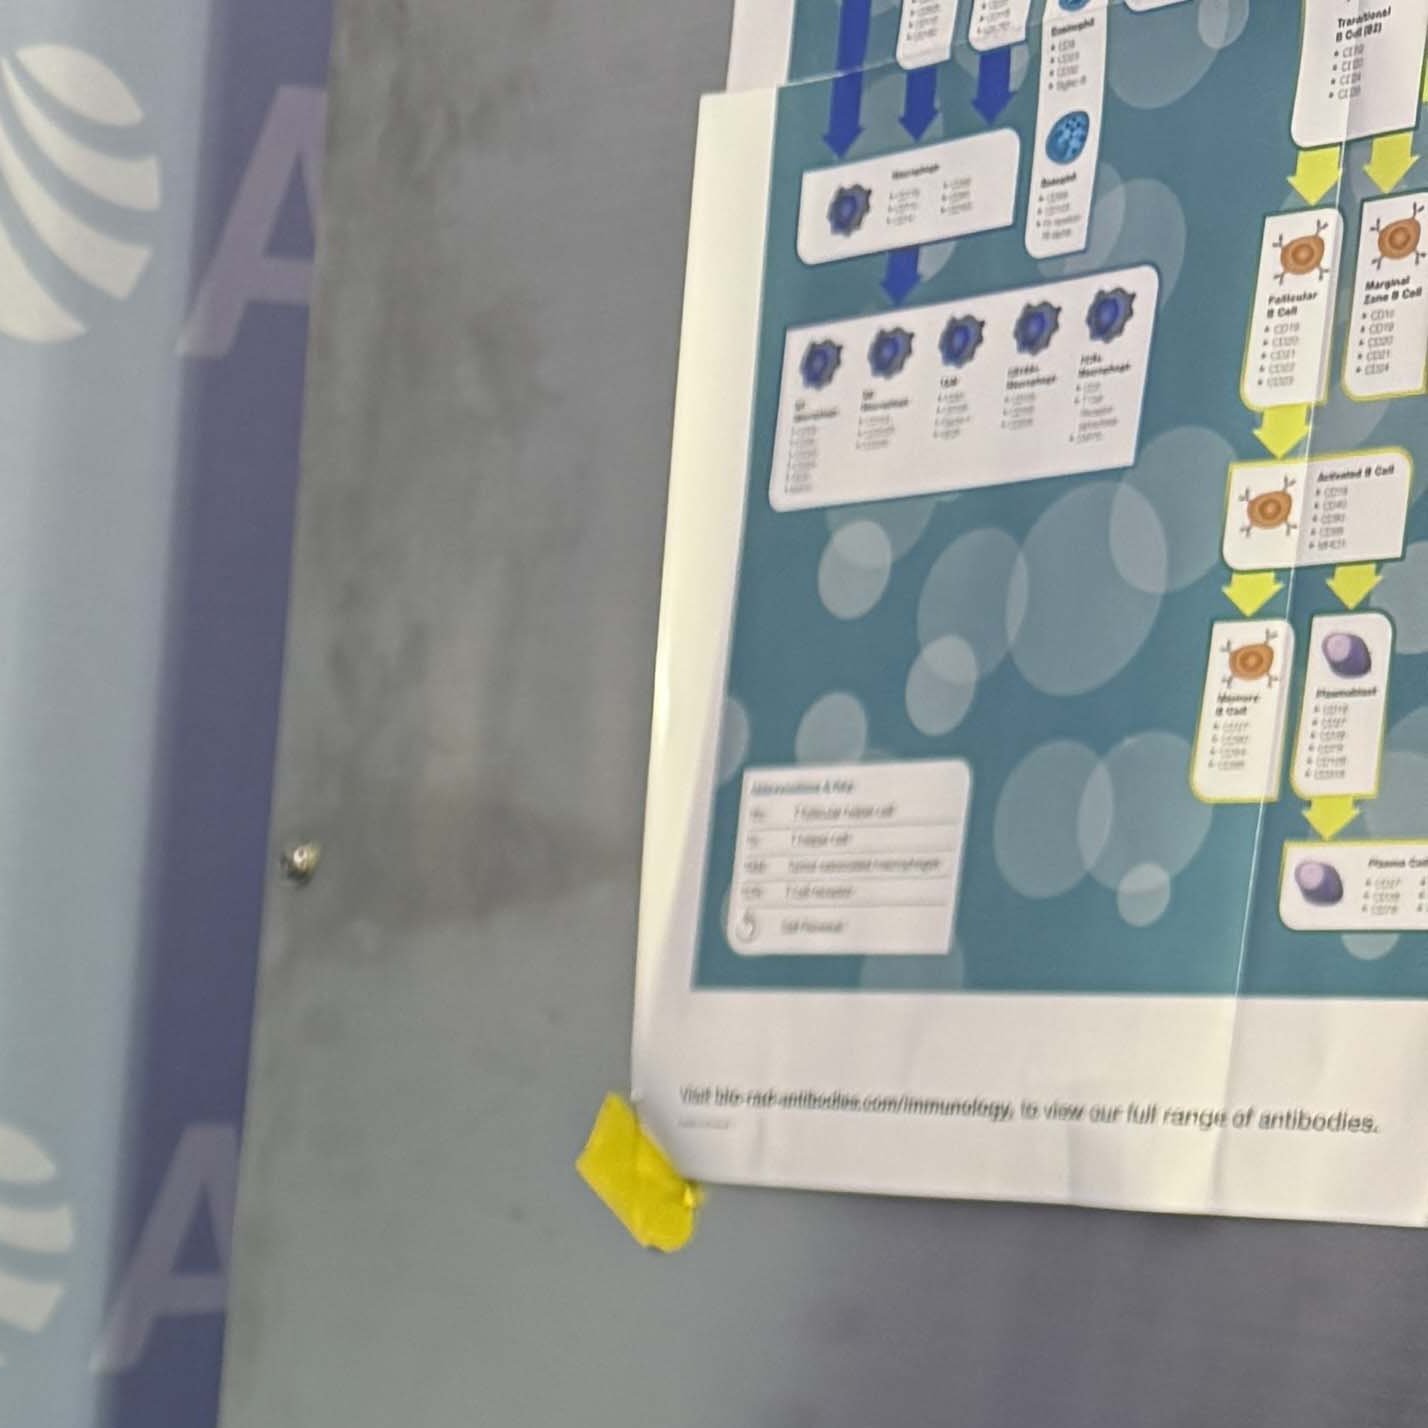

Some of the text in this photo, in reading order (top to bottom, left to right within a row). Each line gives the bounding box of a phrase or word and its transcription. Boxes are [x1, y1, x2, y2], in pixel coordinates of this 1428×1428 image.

[1044, 1103, 1083, 1121] view
[1089, 1106, 1123, 1124] our
[1126, 1102, 1157, 1125] full
[1162, 1107, 1226, 1132] range
[1232, 1105, 1252, 1129] of
[1258, 1107, 1380, 1135] antibodies.
